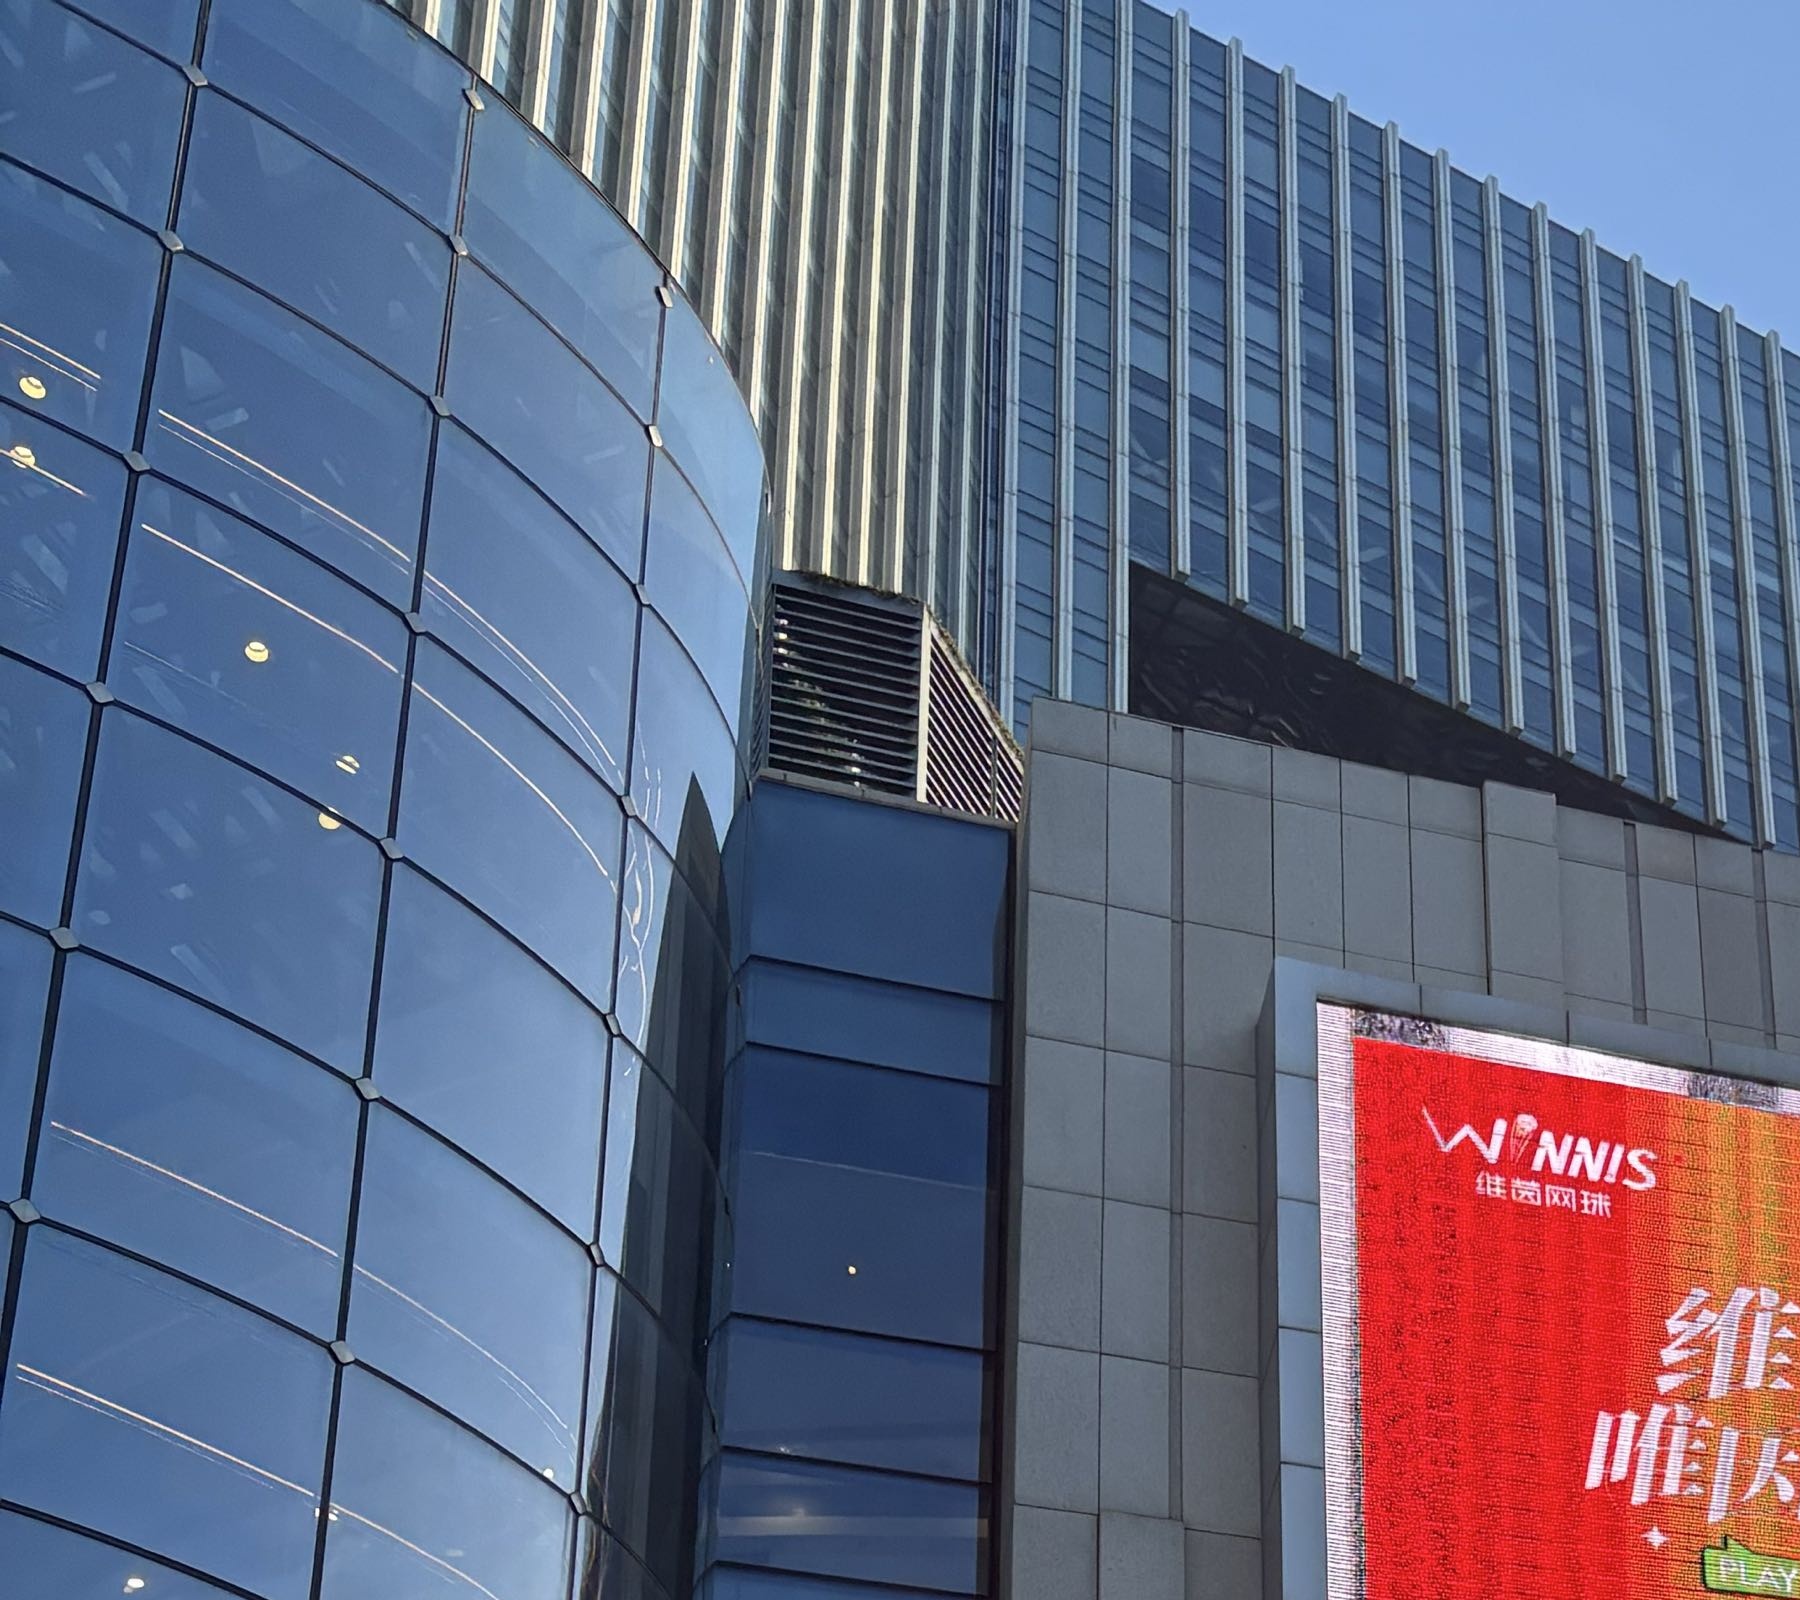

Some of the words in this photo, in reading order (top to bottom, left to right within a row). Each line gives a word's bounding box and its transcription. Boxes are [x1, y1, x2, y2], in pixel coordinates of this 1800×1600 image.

[1475, 1171, 1612, 1218] 维茵网球
[1719, 1559, 1798, 1592] PLAY
